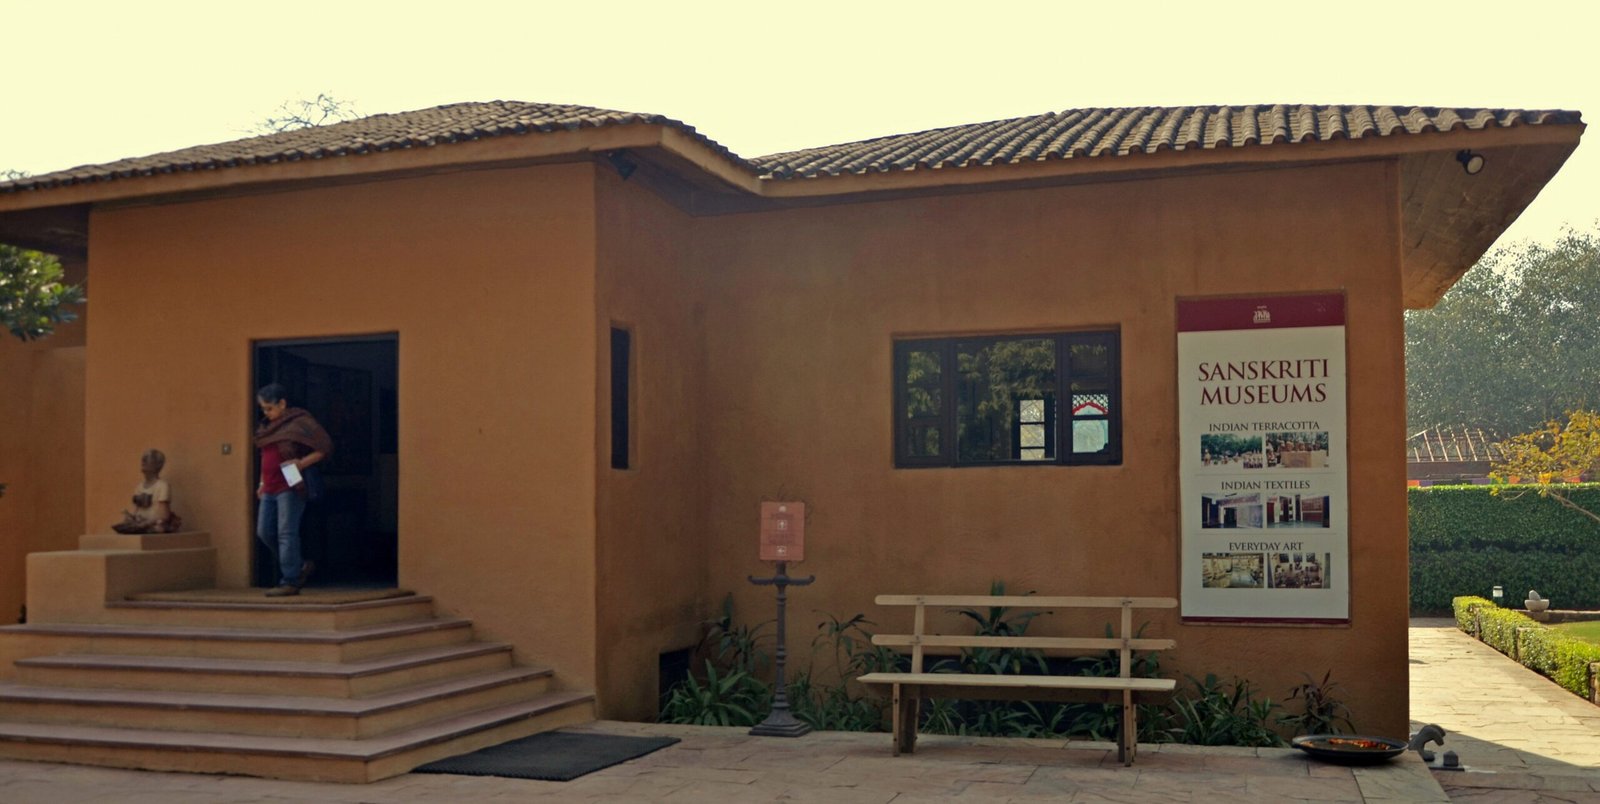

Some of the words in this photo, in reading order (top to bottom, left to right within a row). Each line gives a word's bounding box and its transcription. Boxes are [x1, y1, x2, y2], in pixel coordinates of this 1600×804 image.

[1198, 358, 1331, 382] SANSKRITI
[1200, 382, 1328, 406] MUSEUMS
[1209, 423, 1249, 432] INDIAN
[1251, 421, 1320, 431] TERRACOTTA
[1221, 481, 1261, 490] INDIAN
[1263, 480, 1311, 489] TEXTILES
[1229, 542, 1281, 551] EVERYDAY
[1283, 542, 1304, 551] ART
